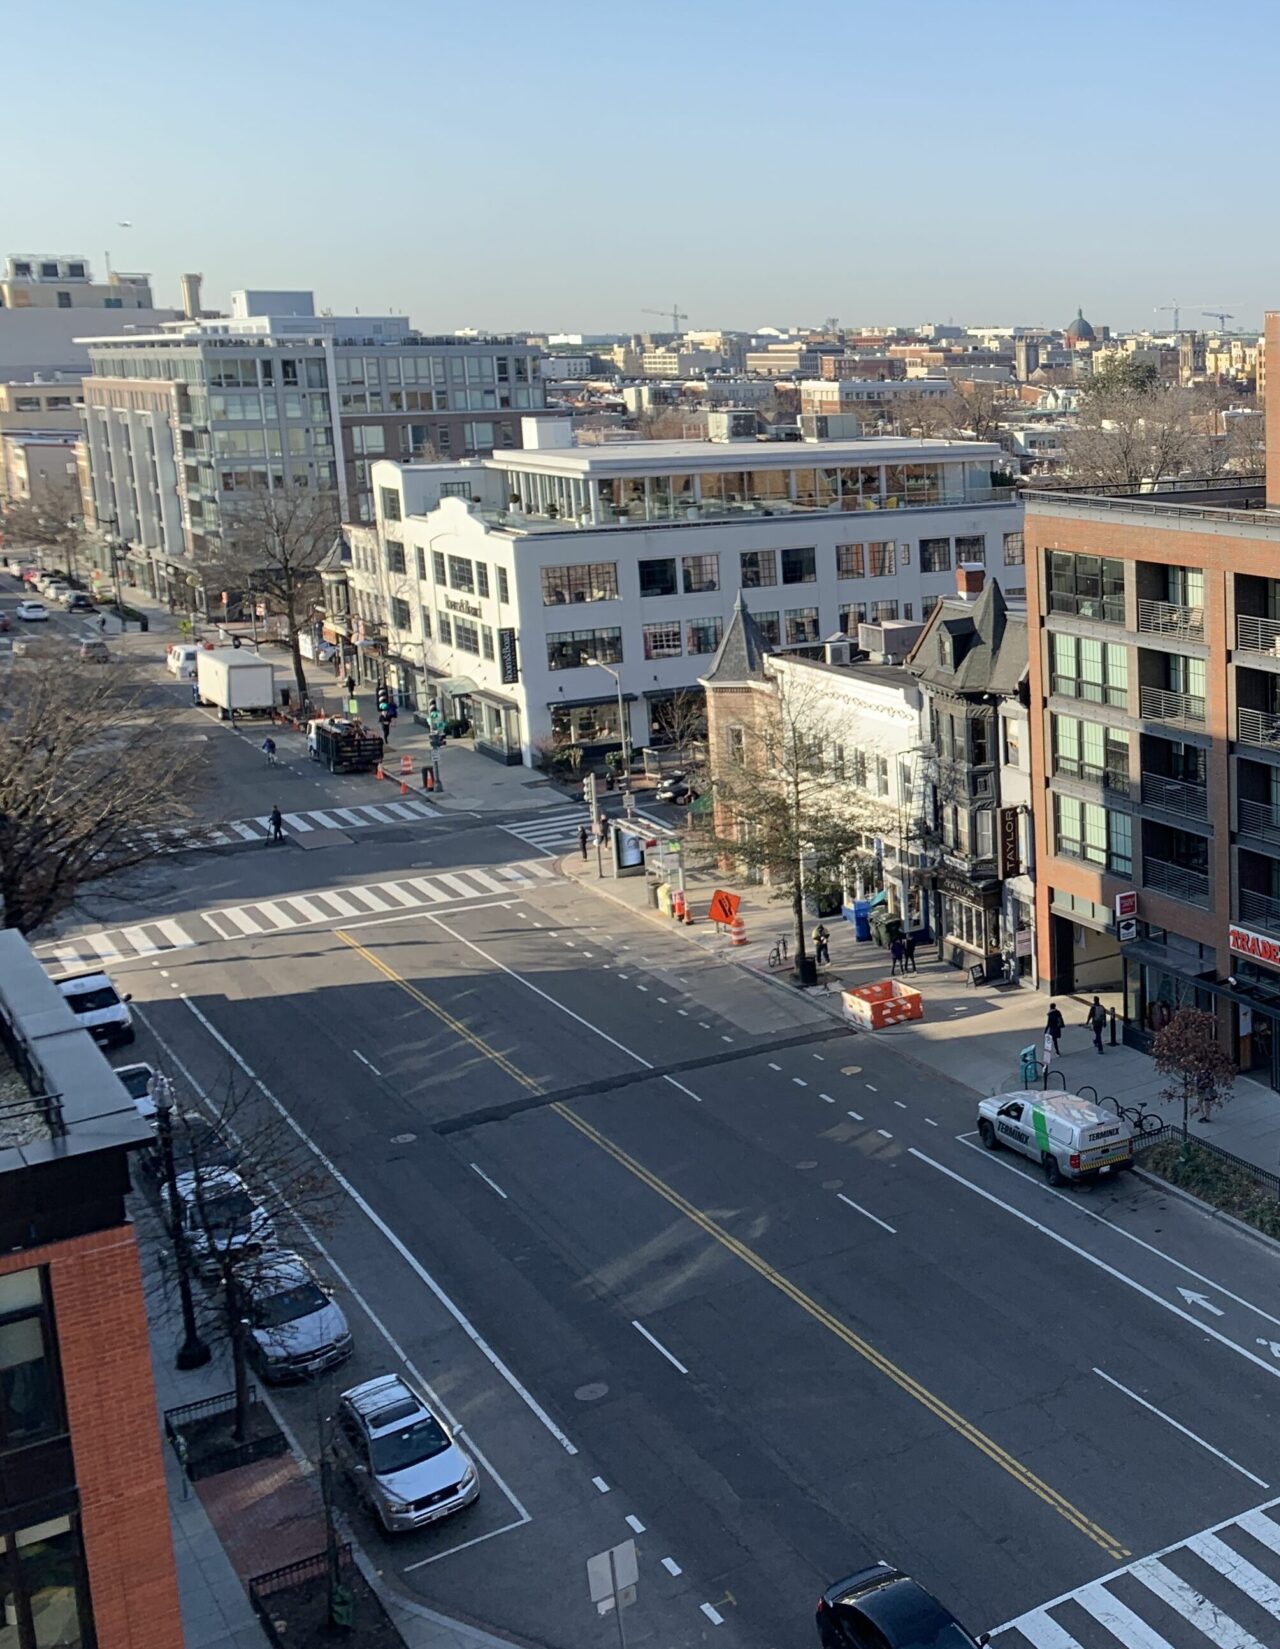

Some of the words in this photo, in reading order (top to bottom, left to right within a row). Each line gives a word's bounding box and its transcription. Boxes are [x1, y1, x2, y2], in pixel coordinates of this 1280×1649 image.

[1005, 809, 1015, 872] TAYLOR
[997, 1120, 1030, 1145] TERMINIX
[1088, 1127, 1120, 1142] TERMINIX
